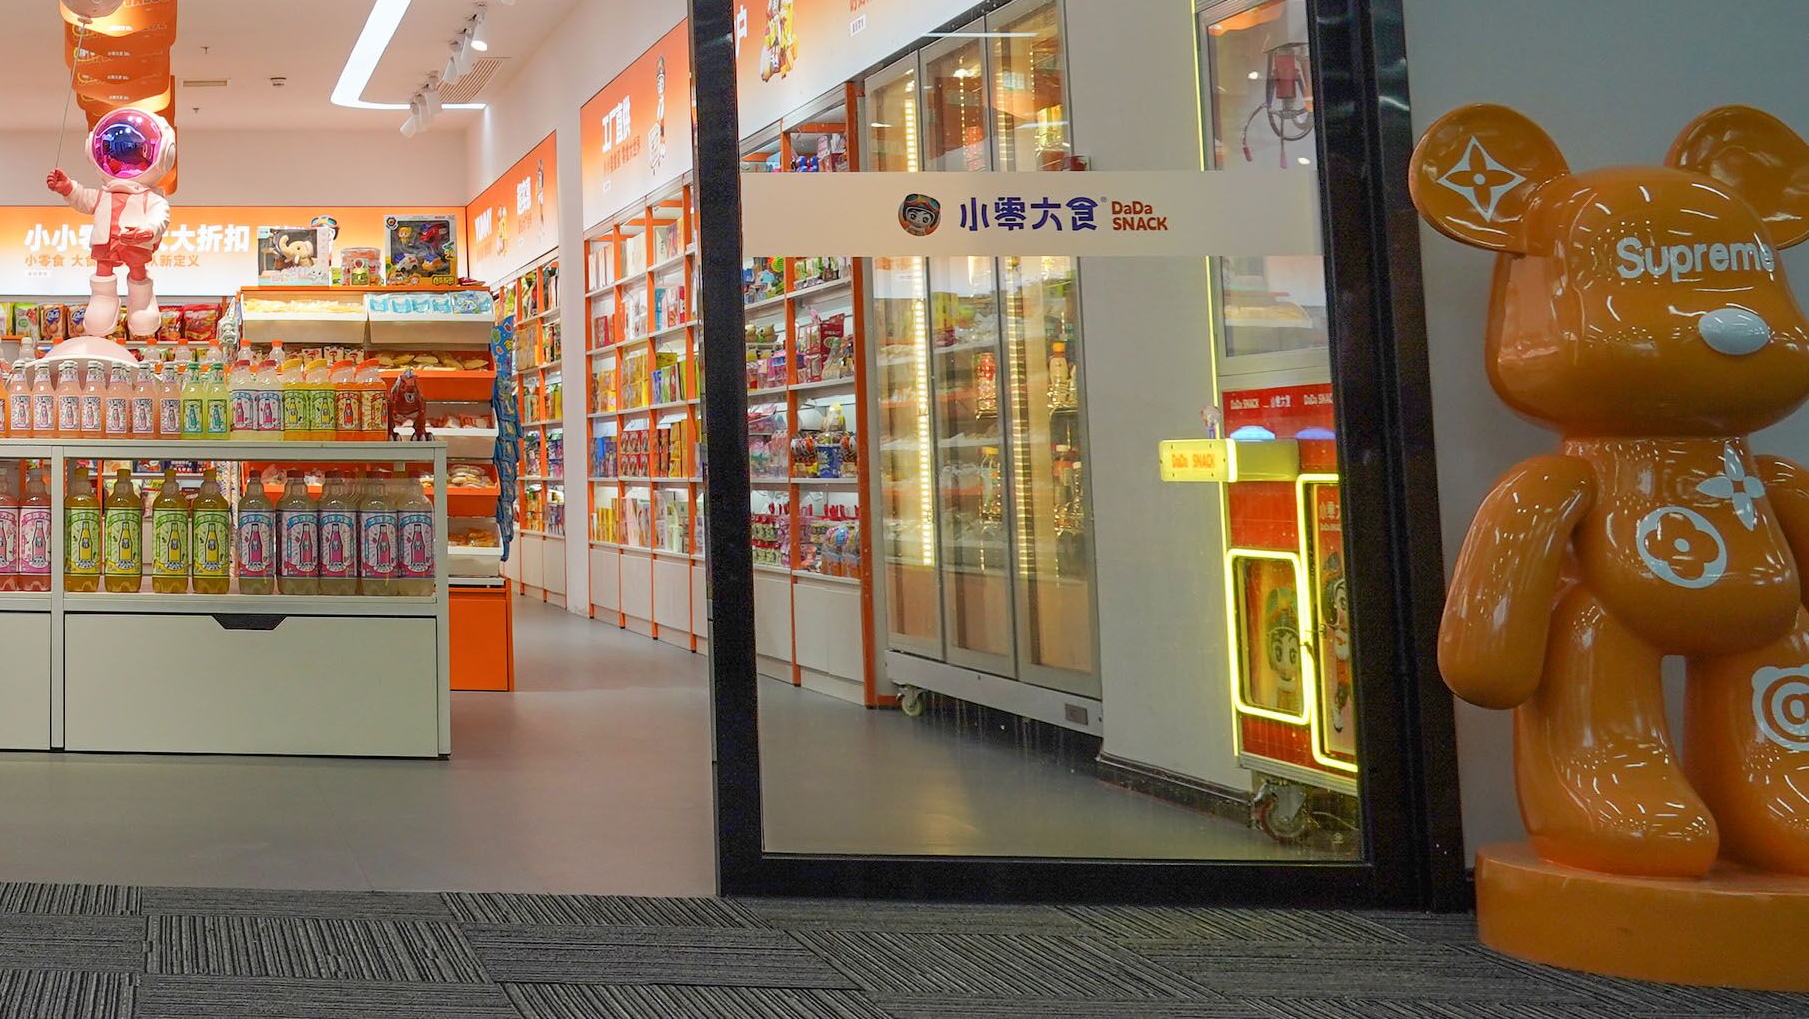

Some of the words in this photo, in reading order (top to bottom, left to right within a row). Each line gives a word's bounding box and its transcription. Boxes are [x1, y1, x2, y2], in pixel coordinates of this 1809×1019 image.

[1112, 201, 1152, 215] DaDa
[1113, 217, 1168, 231] SNACK
[1615, 236, 1775, 281] Supreme
